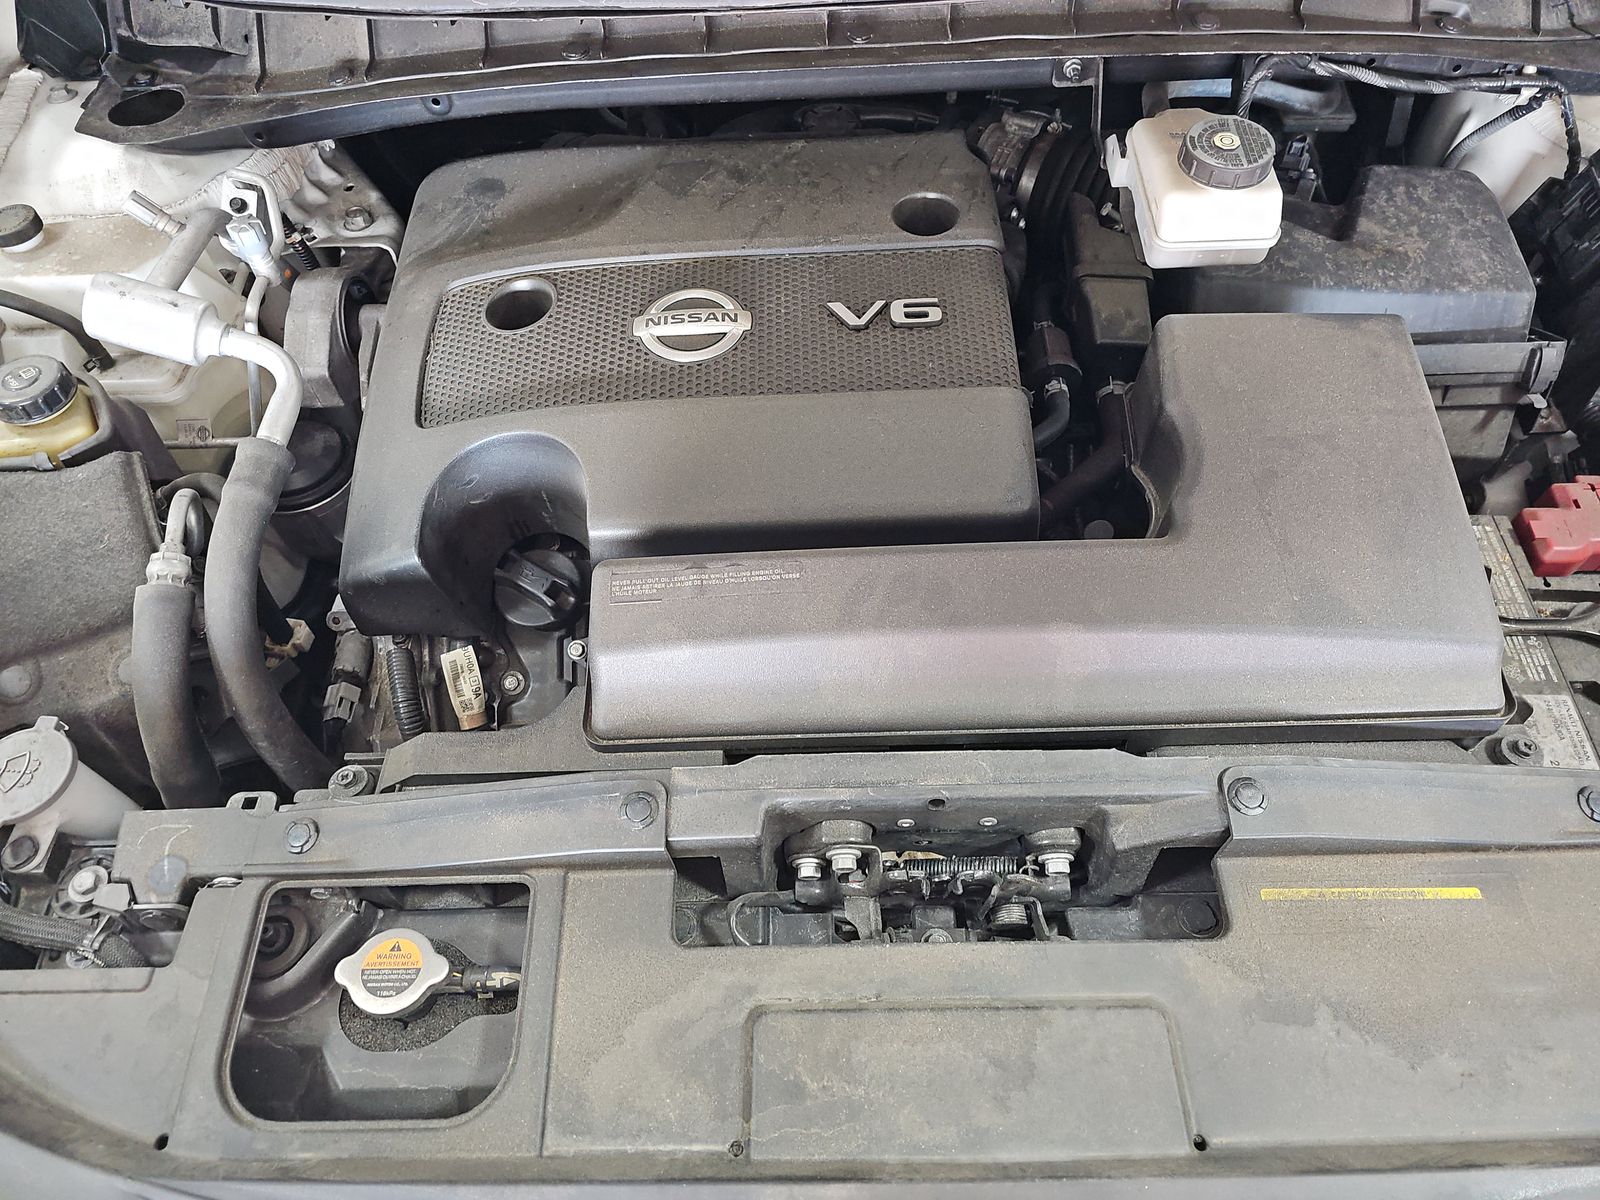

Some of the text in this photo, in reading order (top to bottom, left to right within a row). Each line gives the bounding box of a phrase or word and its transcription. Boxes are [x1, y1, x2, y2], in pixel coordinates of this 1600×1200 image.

[644, 311, 739, 329] NISSAN
[826, 297, 943, 331] V6
[660, 576, 671, 584] OIL
[471, 686, 482, 700] 9A
[1574, 730, 1591, 761] NISSAN
[376, 952, 412, 960] WARNING
